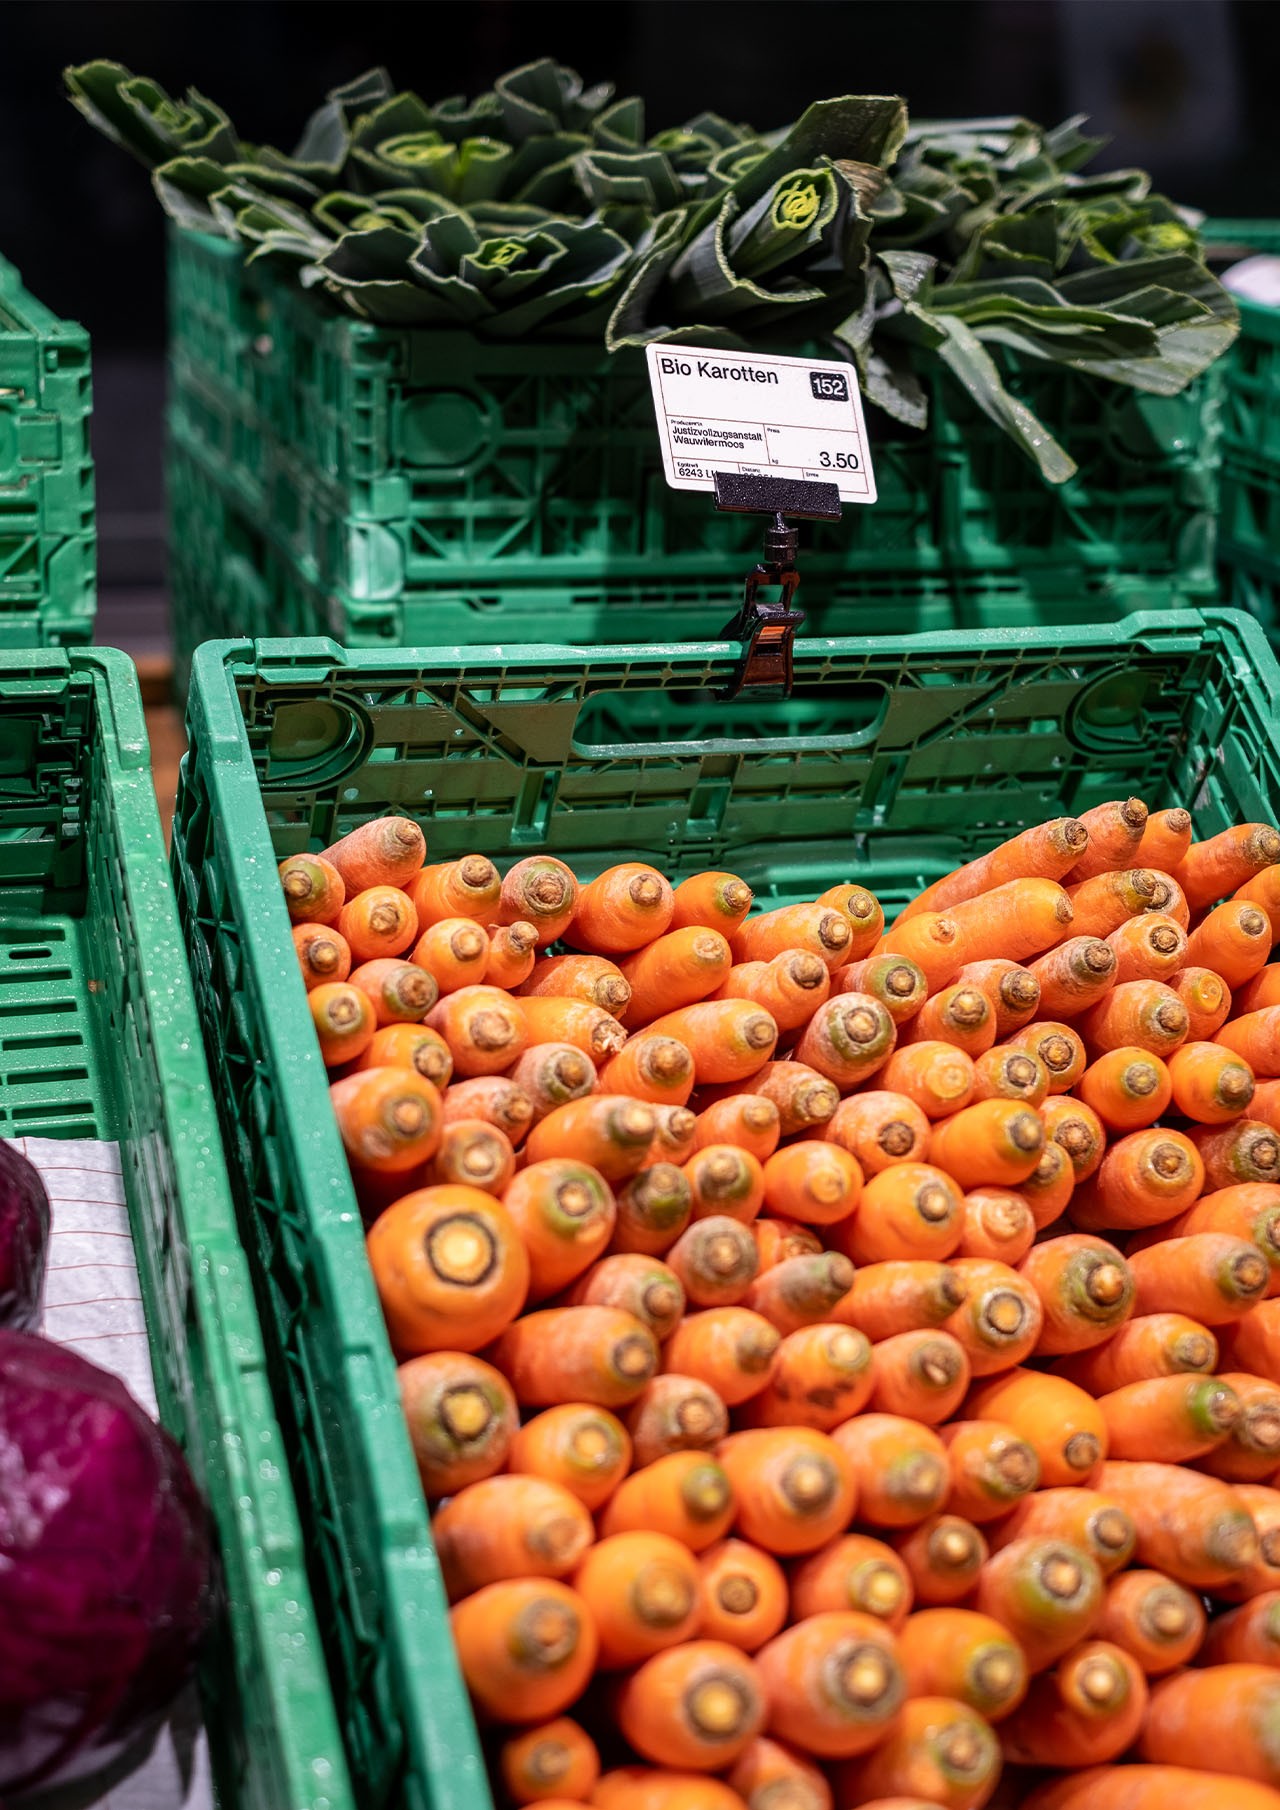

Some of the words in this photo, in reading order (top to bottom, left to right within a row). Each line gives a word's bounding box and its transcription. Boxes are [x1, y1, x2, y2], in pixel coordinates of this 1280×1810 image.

[661, 358, 692, 375] Bio
[698, 361, 779, 385] Karotten
[813, 378, 846, 396] 152
[672, 426, 763, 441] Justizvollzugsanstalt
[673, 435, 744, 449] Wauwilermoos
[819, 451, 859, 470] 3.50
[678, 468, 704, 478] 6243
